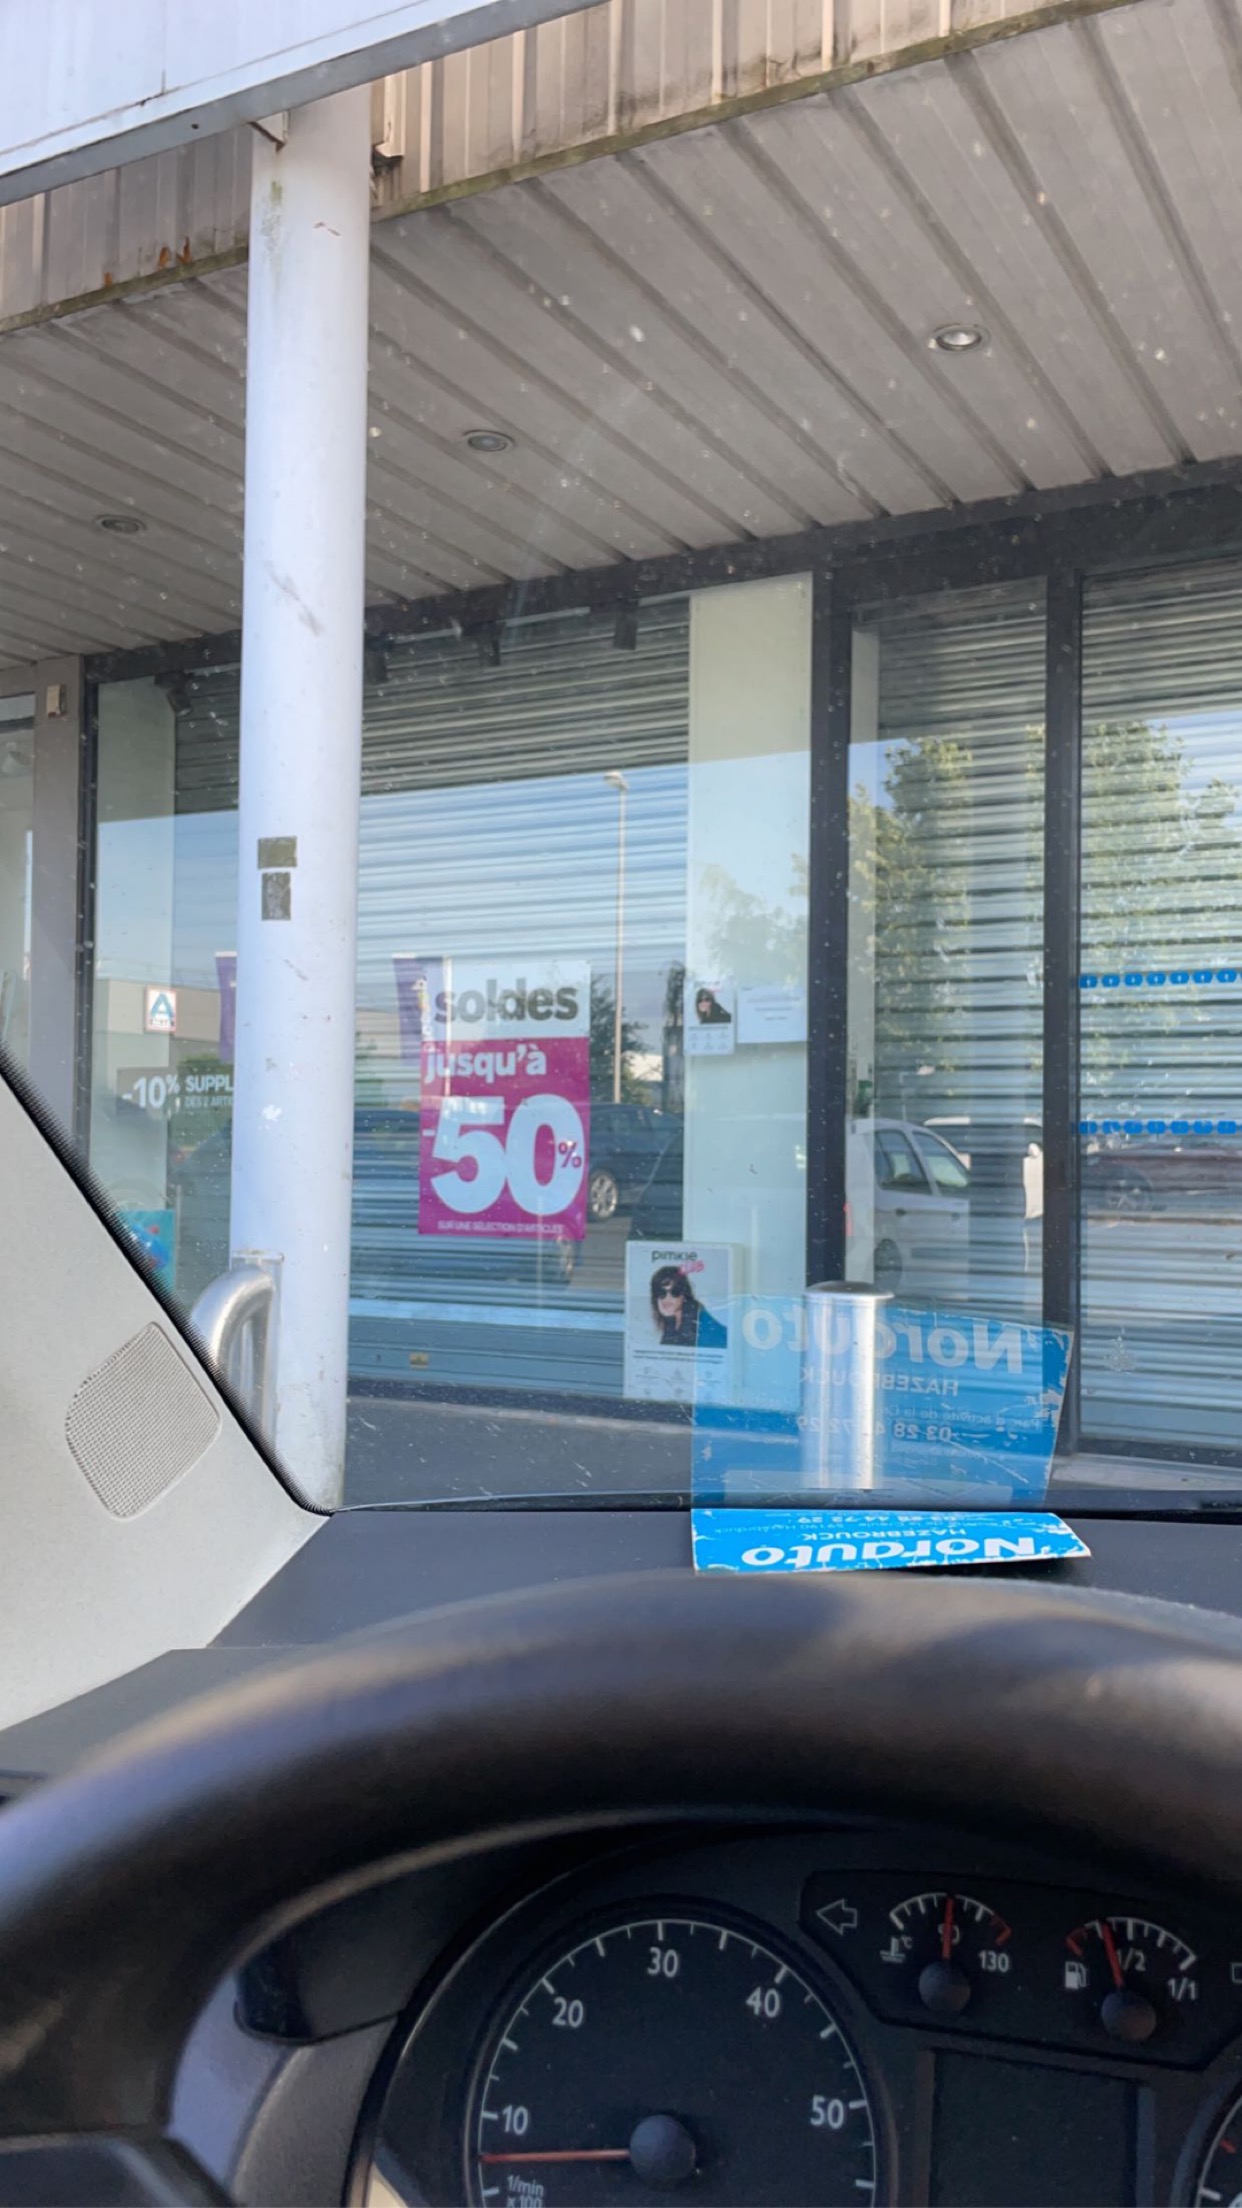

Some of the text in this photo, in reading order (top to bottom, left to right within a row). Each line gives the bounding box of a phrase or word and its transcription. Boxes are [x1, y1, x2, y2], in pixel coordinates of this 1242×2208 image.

[434, 977, 580, 1024] soldes
[424, 1043, 548, 1085] jusqu'à
[121, 1073, 181, 1109] -10%
[437, 1219, 453, 1230] SUR
[455, 1220, 470, 1230] UNE
[803, 1528, 967, 1541] HAZEBROUCK
[740, 1536, 1036, 1569] Norauto
[647, 1947, 680, 1979] 30
[978, 1949, 1010, 1973] 130
[745, 1986, 782, 2019] 40
[1167, 1976, 1197, 2001] 1/1
[552, 1998, 585, 2030] 20
[501, 2106, 529, 2136] 10
[810, 2097, 845, 2130] 50
